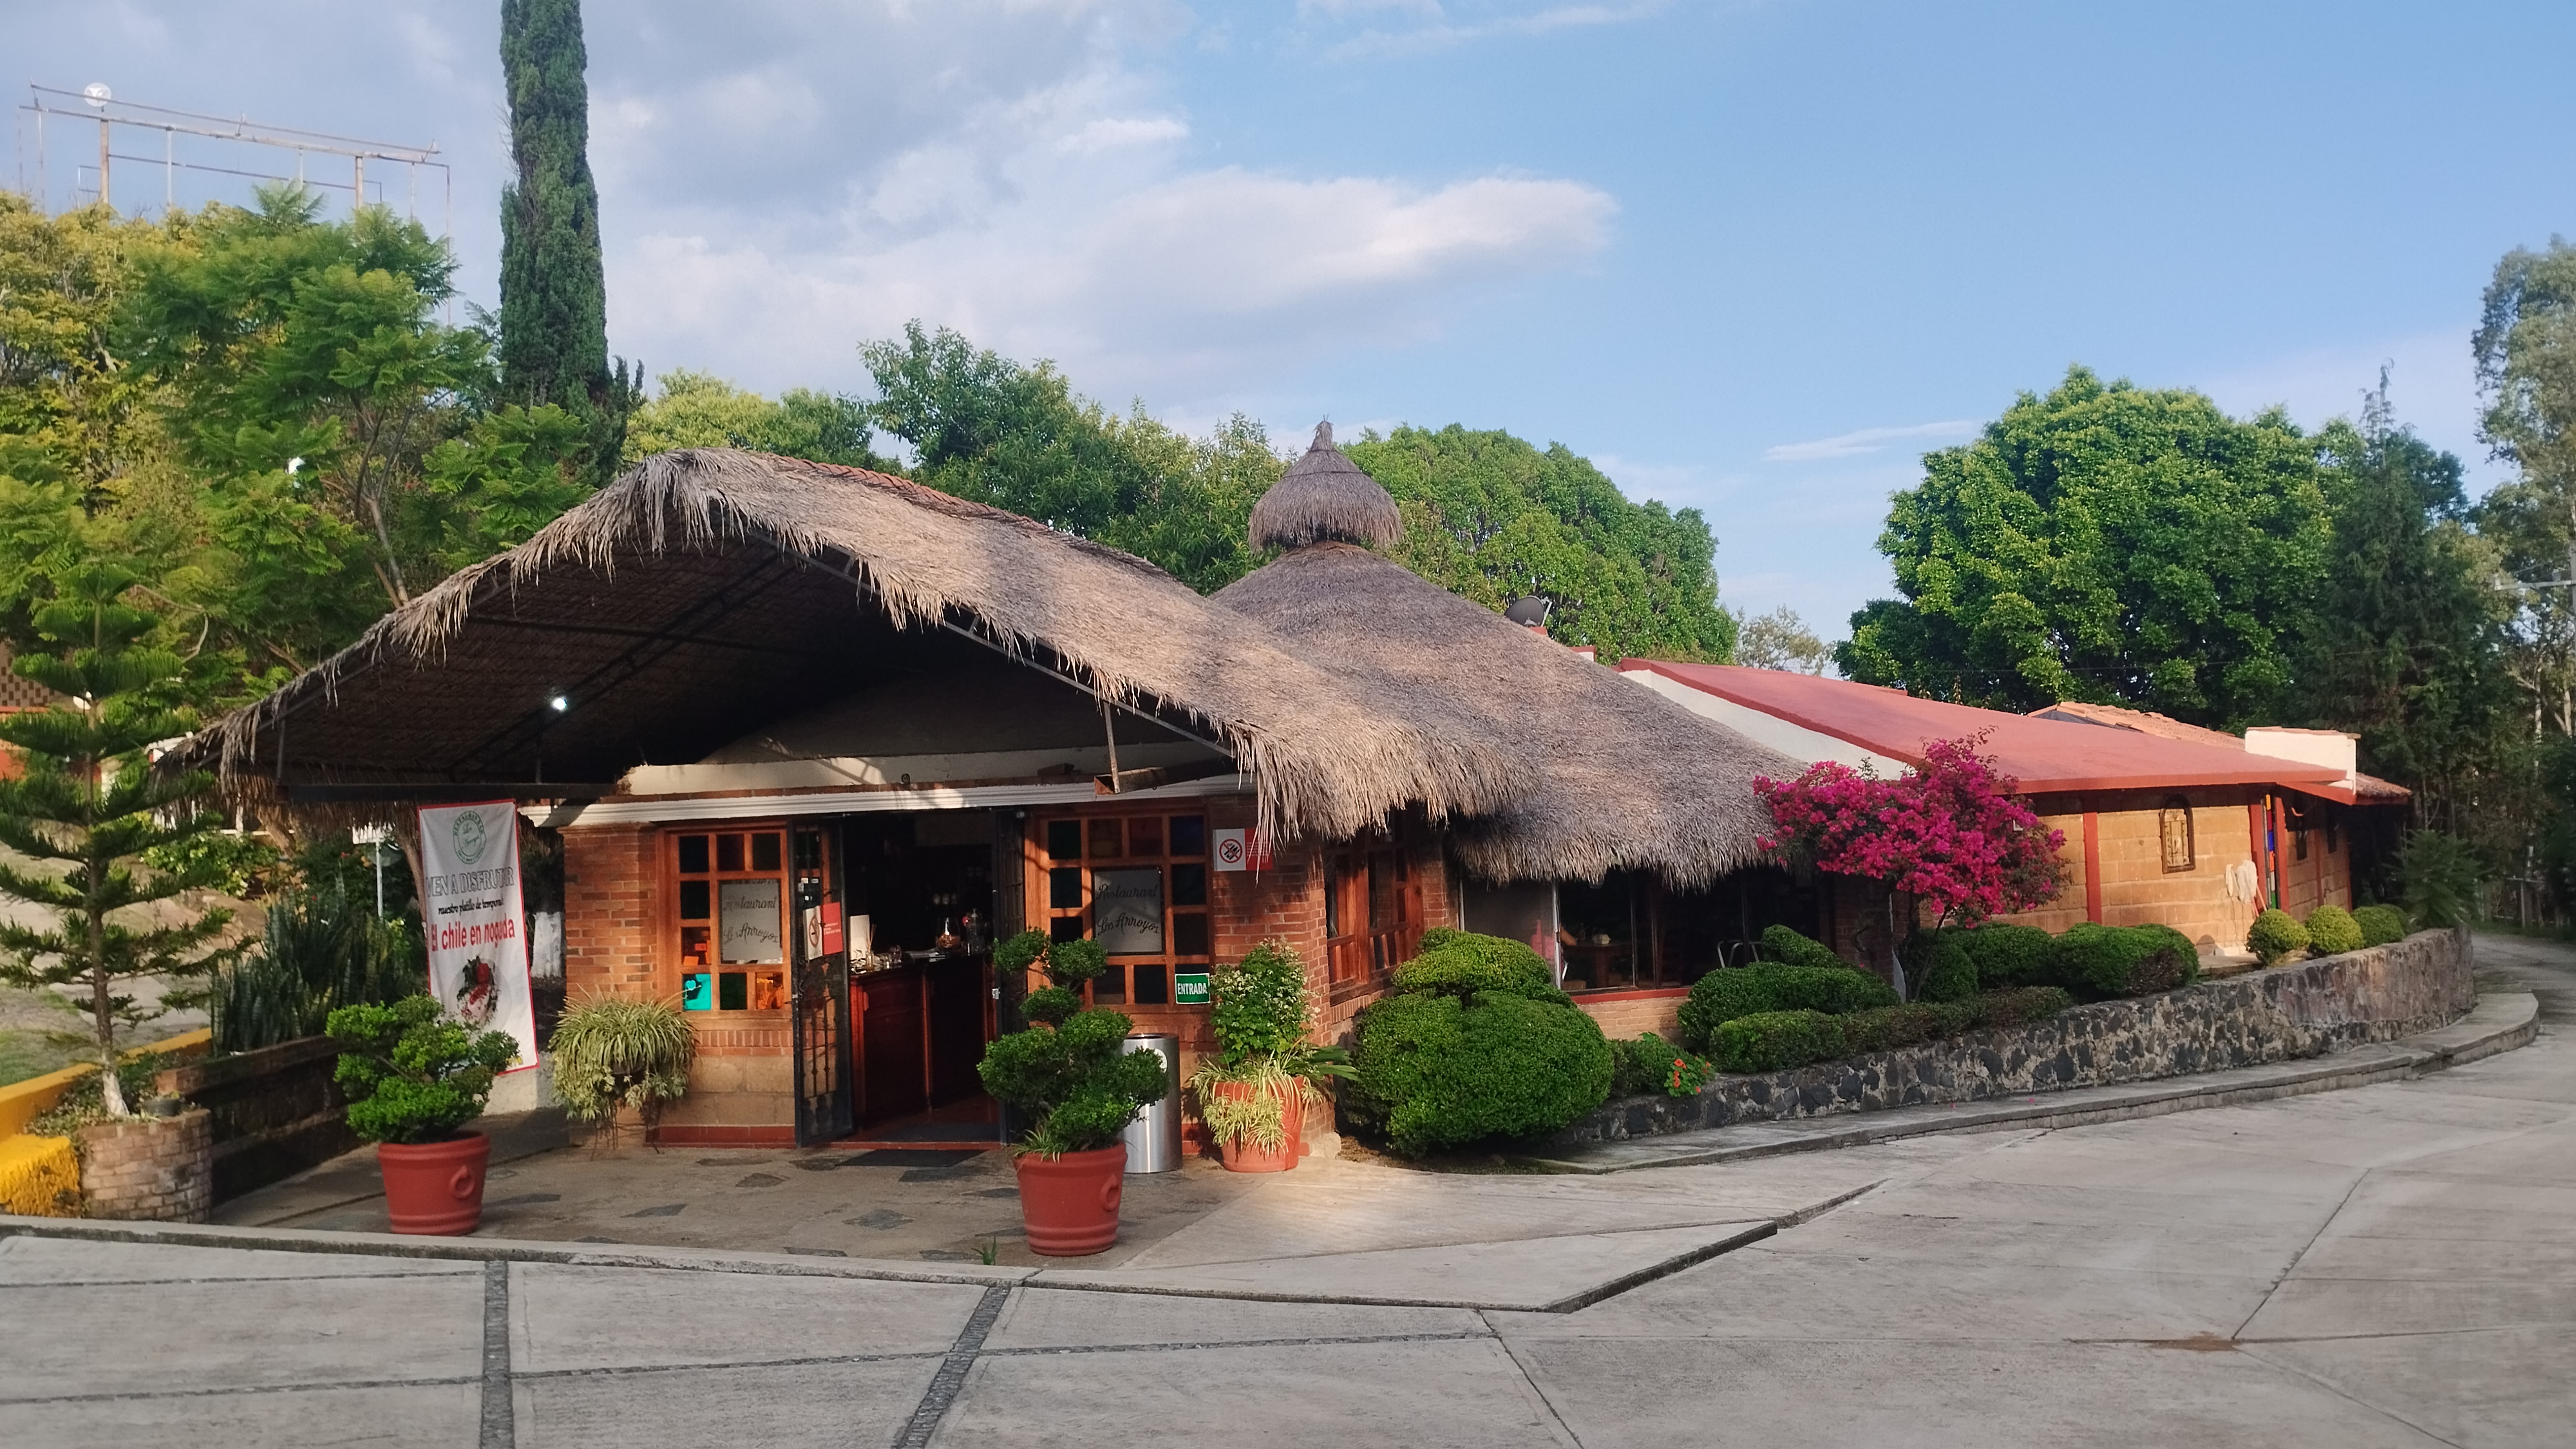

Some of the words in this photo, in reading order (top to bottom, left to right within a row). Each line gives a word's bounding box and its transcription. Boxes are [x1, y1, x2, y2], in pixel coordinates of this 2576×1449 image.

[451, 874, 459, 895] A
[1096, 883, 1158, 901] Restaurant
[1097, 916, 1114, 936] Los
[1115, 912, 1159, 935] Arroyos
[431, 923, 438, 951] El
[442, 921, 467, 950] chile
[470, 925, 482, 945] en
[1177, 982, 1208, 995] ENTRADA
